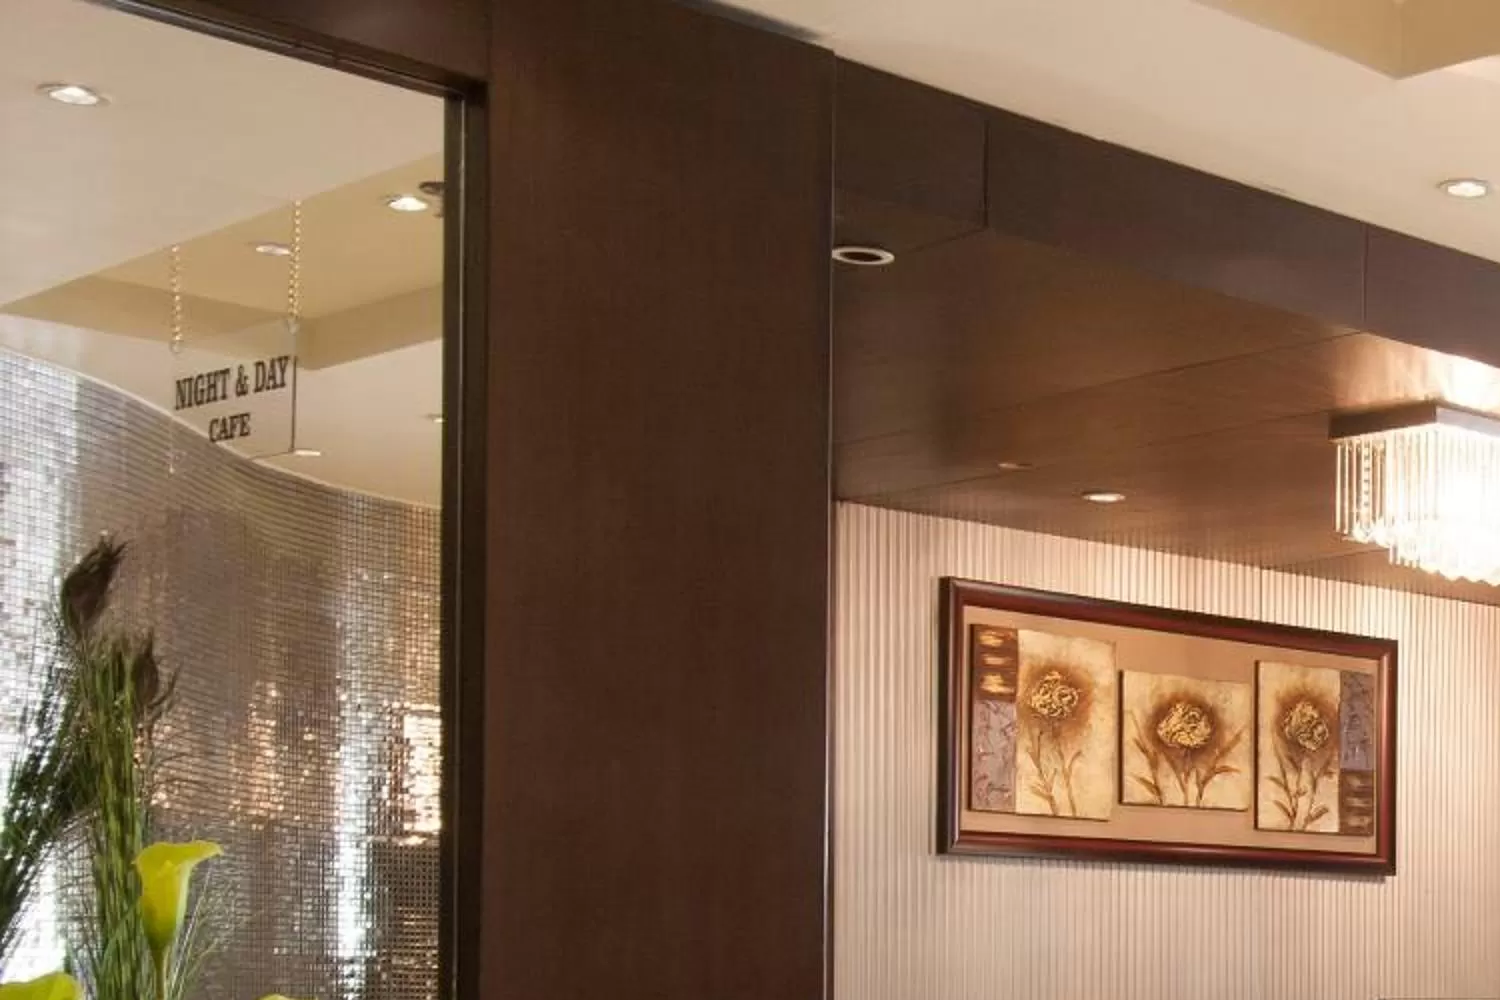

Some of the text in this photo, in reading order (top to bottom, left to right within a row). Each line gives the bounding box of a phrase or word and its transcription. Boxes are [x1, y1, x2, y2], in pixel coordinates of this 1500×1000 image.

[174, 356, 290, 410] NIGHT & DAY
[208, 413, 251, 443] CAFE
